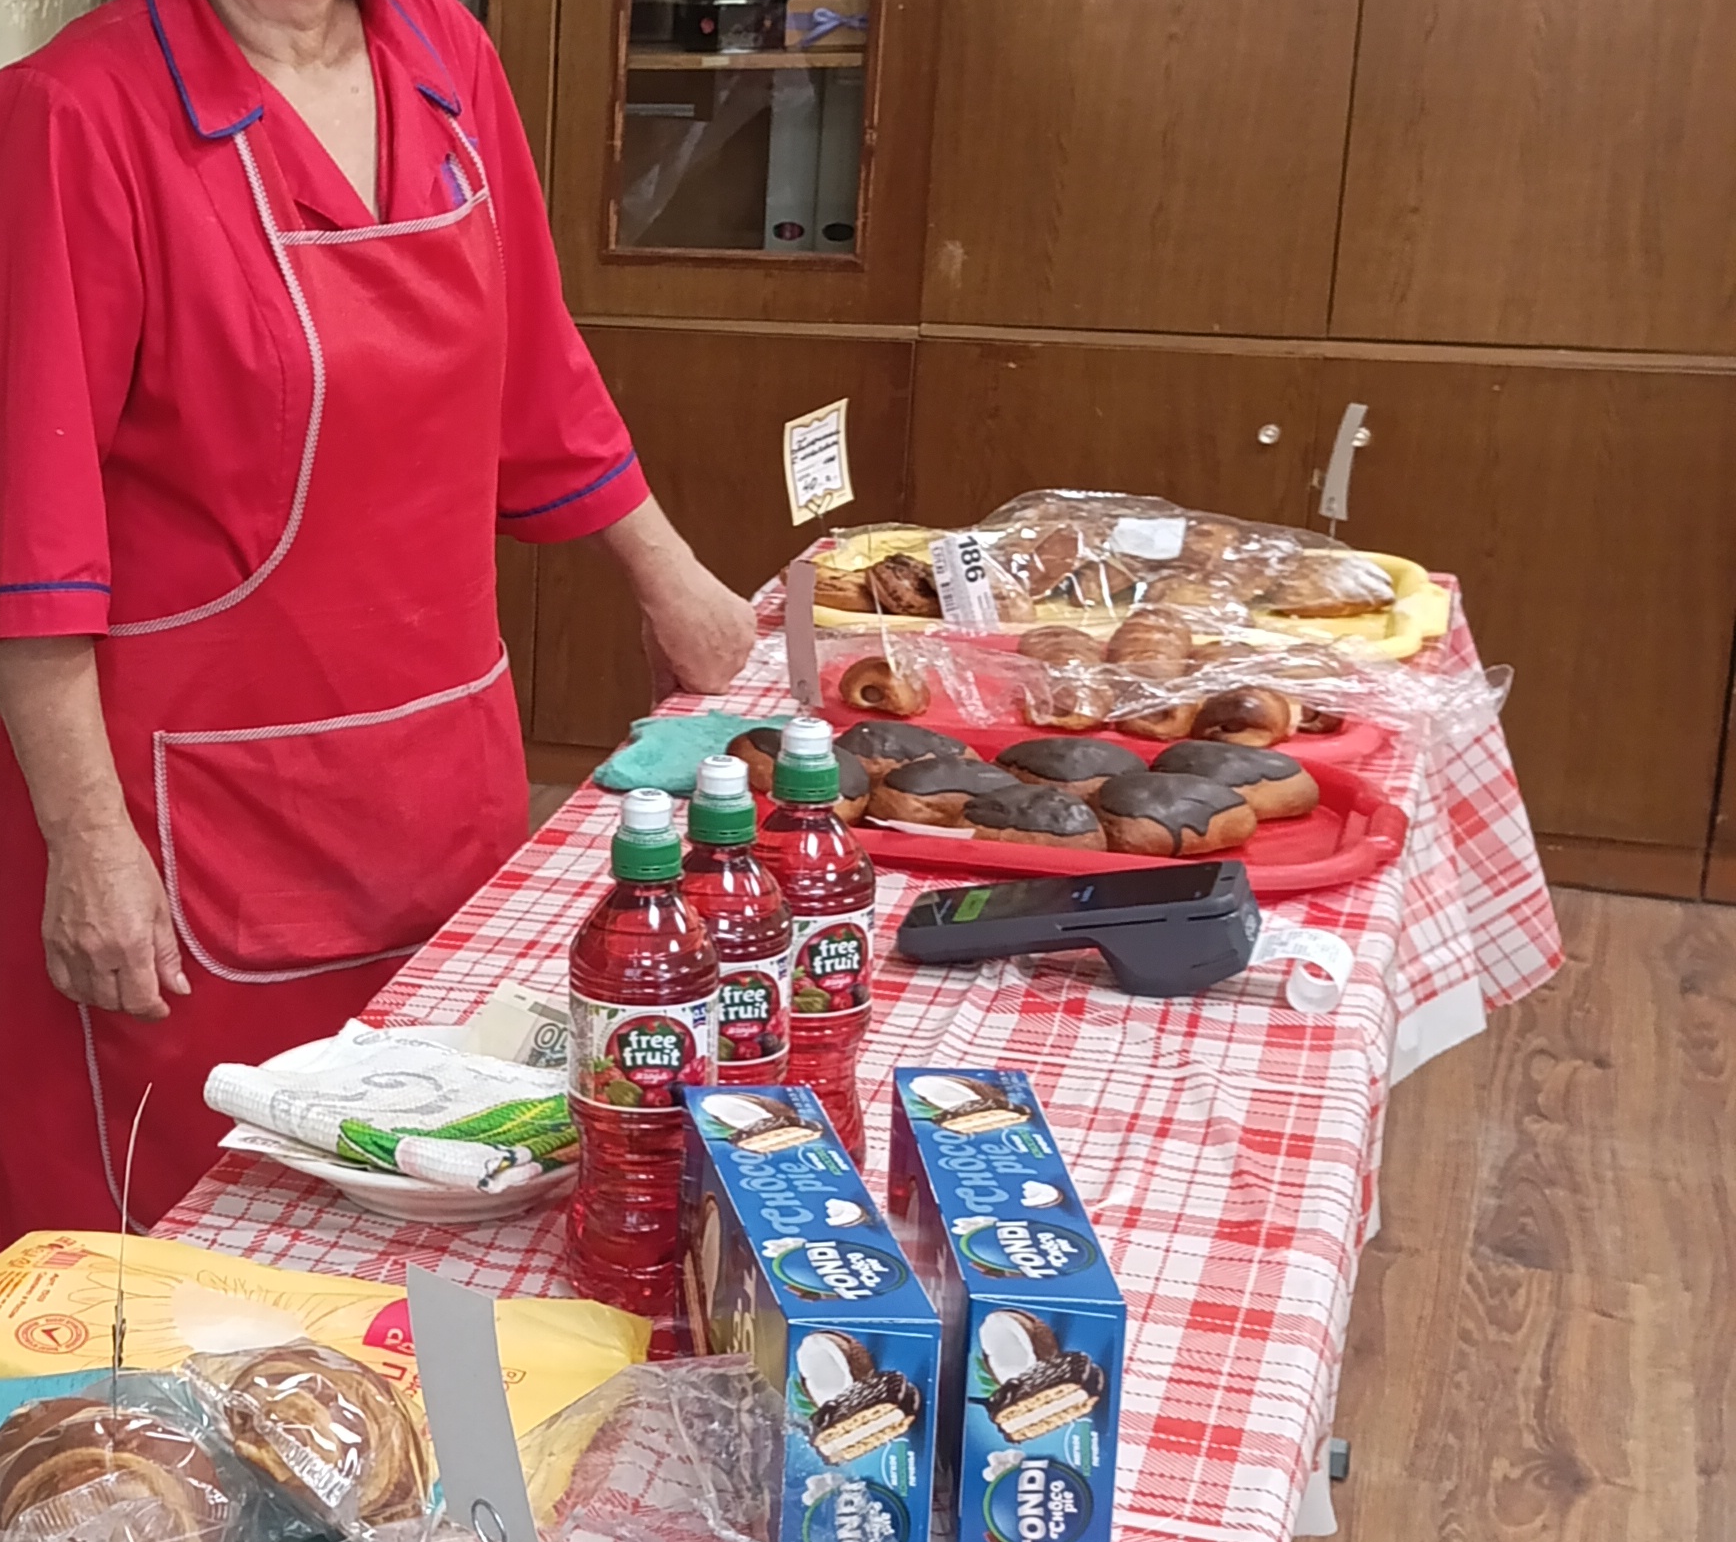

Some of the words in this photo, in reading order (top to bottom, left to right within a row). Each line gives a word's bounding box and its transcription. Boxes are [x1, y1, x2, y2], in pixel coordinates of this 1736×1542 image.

[958, 535, 986, 583] 186
[819, 939, 858, 957] free
[813, 952, 860, 975] fruit
[722, 985, 766, 1004] free
[718, 1001, 768, 1022] fruit
[629, 1030, 677, 1049] free
[622, 1047, 681, 1067] fruit
[996, 1221, 1058, 1279] TONDI
[804, 1241, 873, 1300] TONDI
